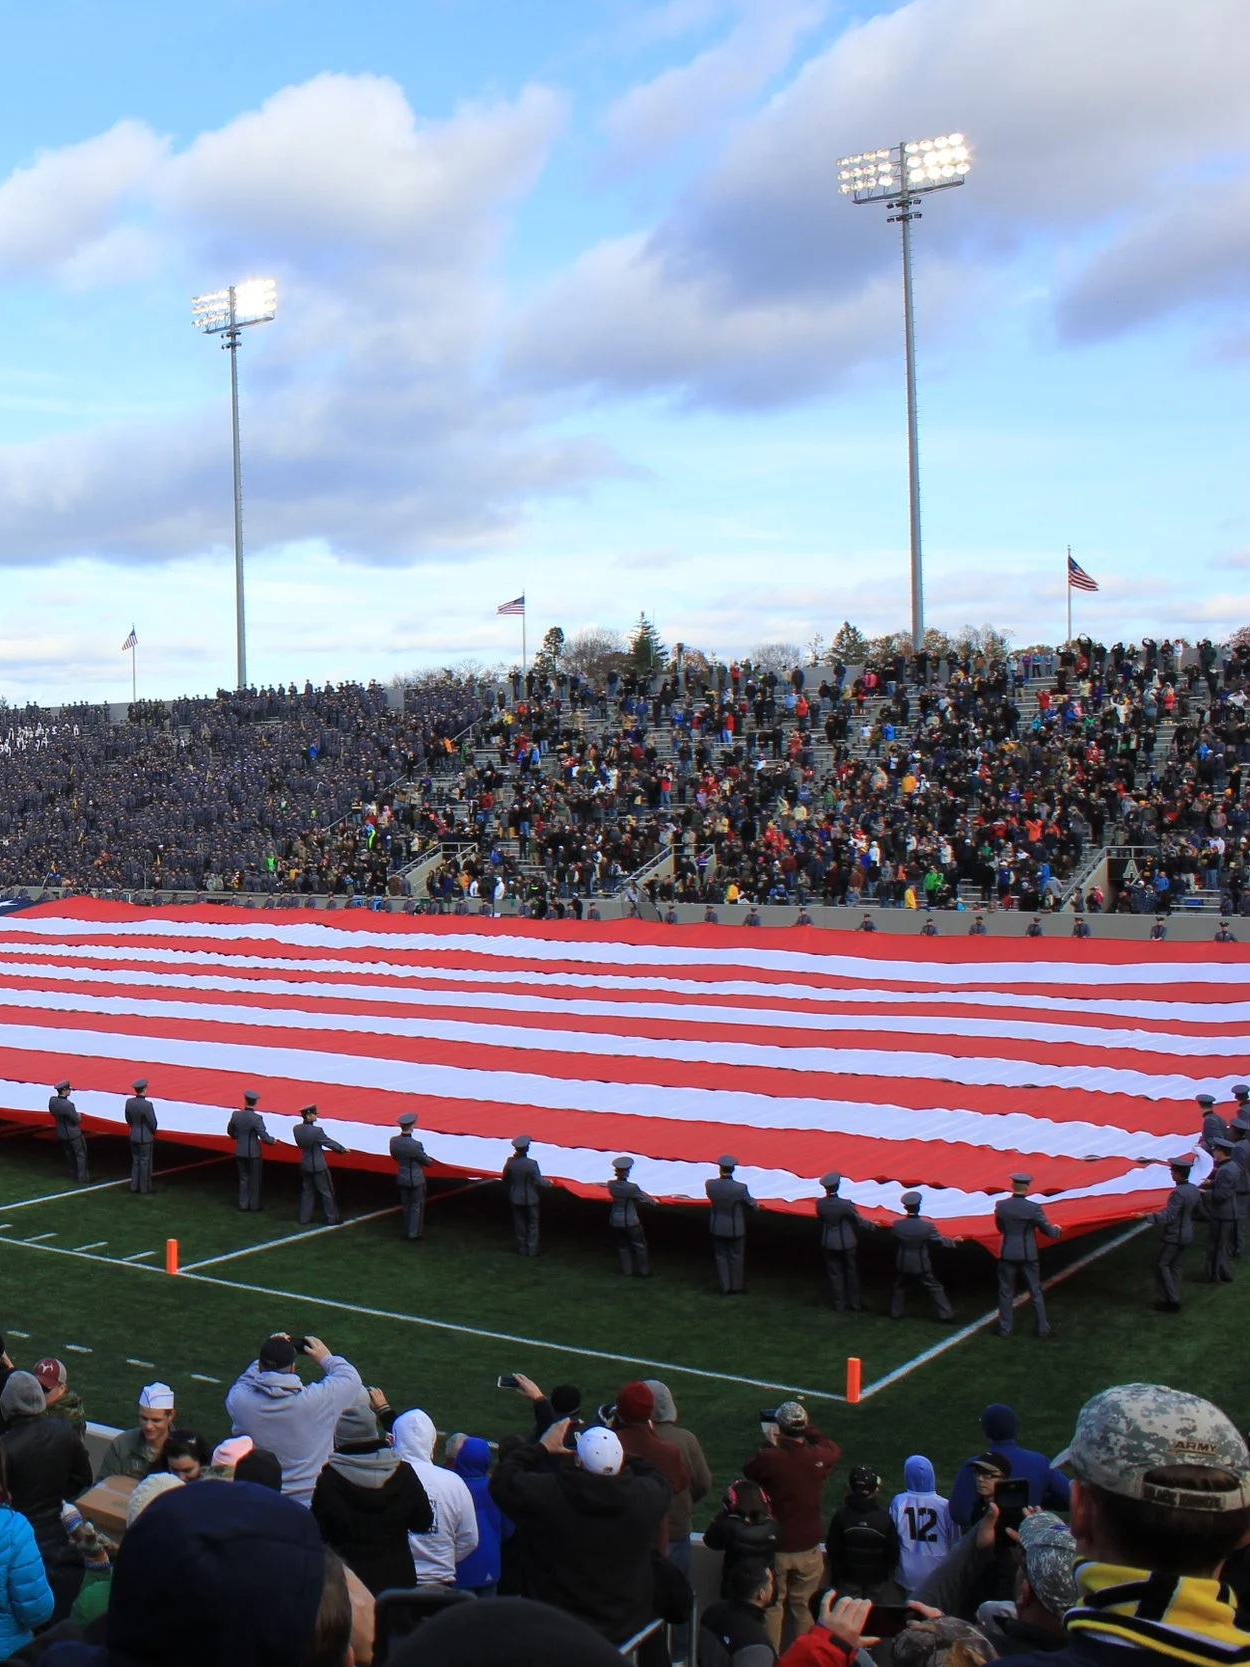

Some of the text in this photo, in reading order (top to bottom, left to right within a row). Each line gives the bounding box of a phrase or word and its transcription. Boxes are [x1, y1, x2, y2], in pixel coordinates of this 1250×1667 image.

[1122, 859, 1140, 879] A
[1174, 1441, 1217, 1452] ARMY
[903, 1506, 938, 1542] 12
